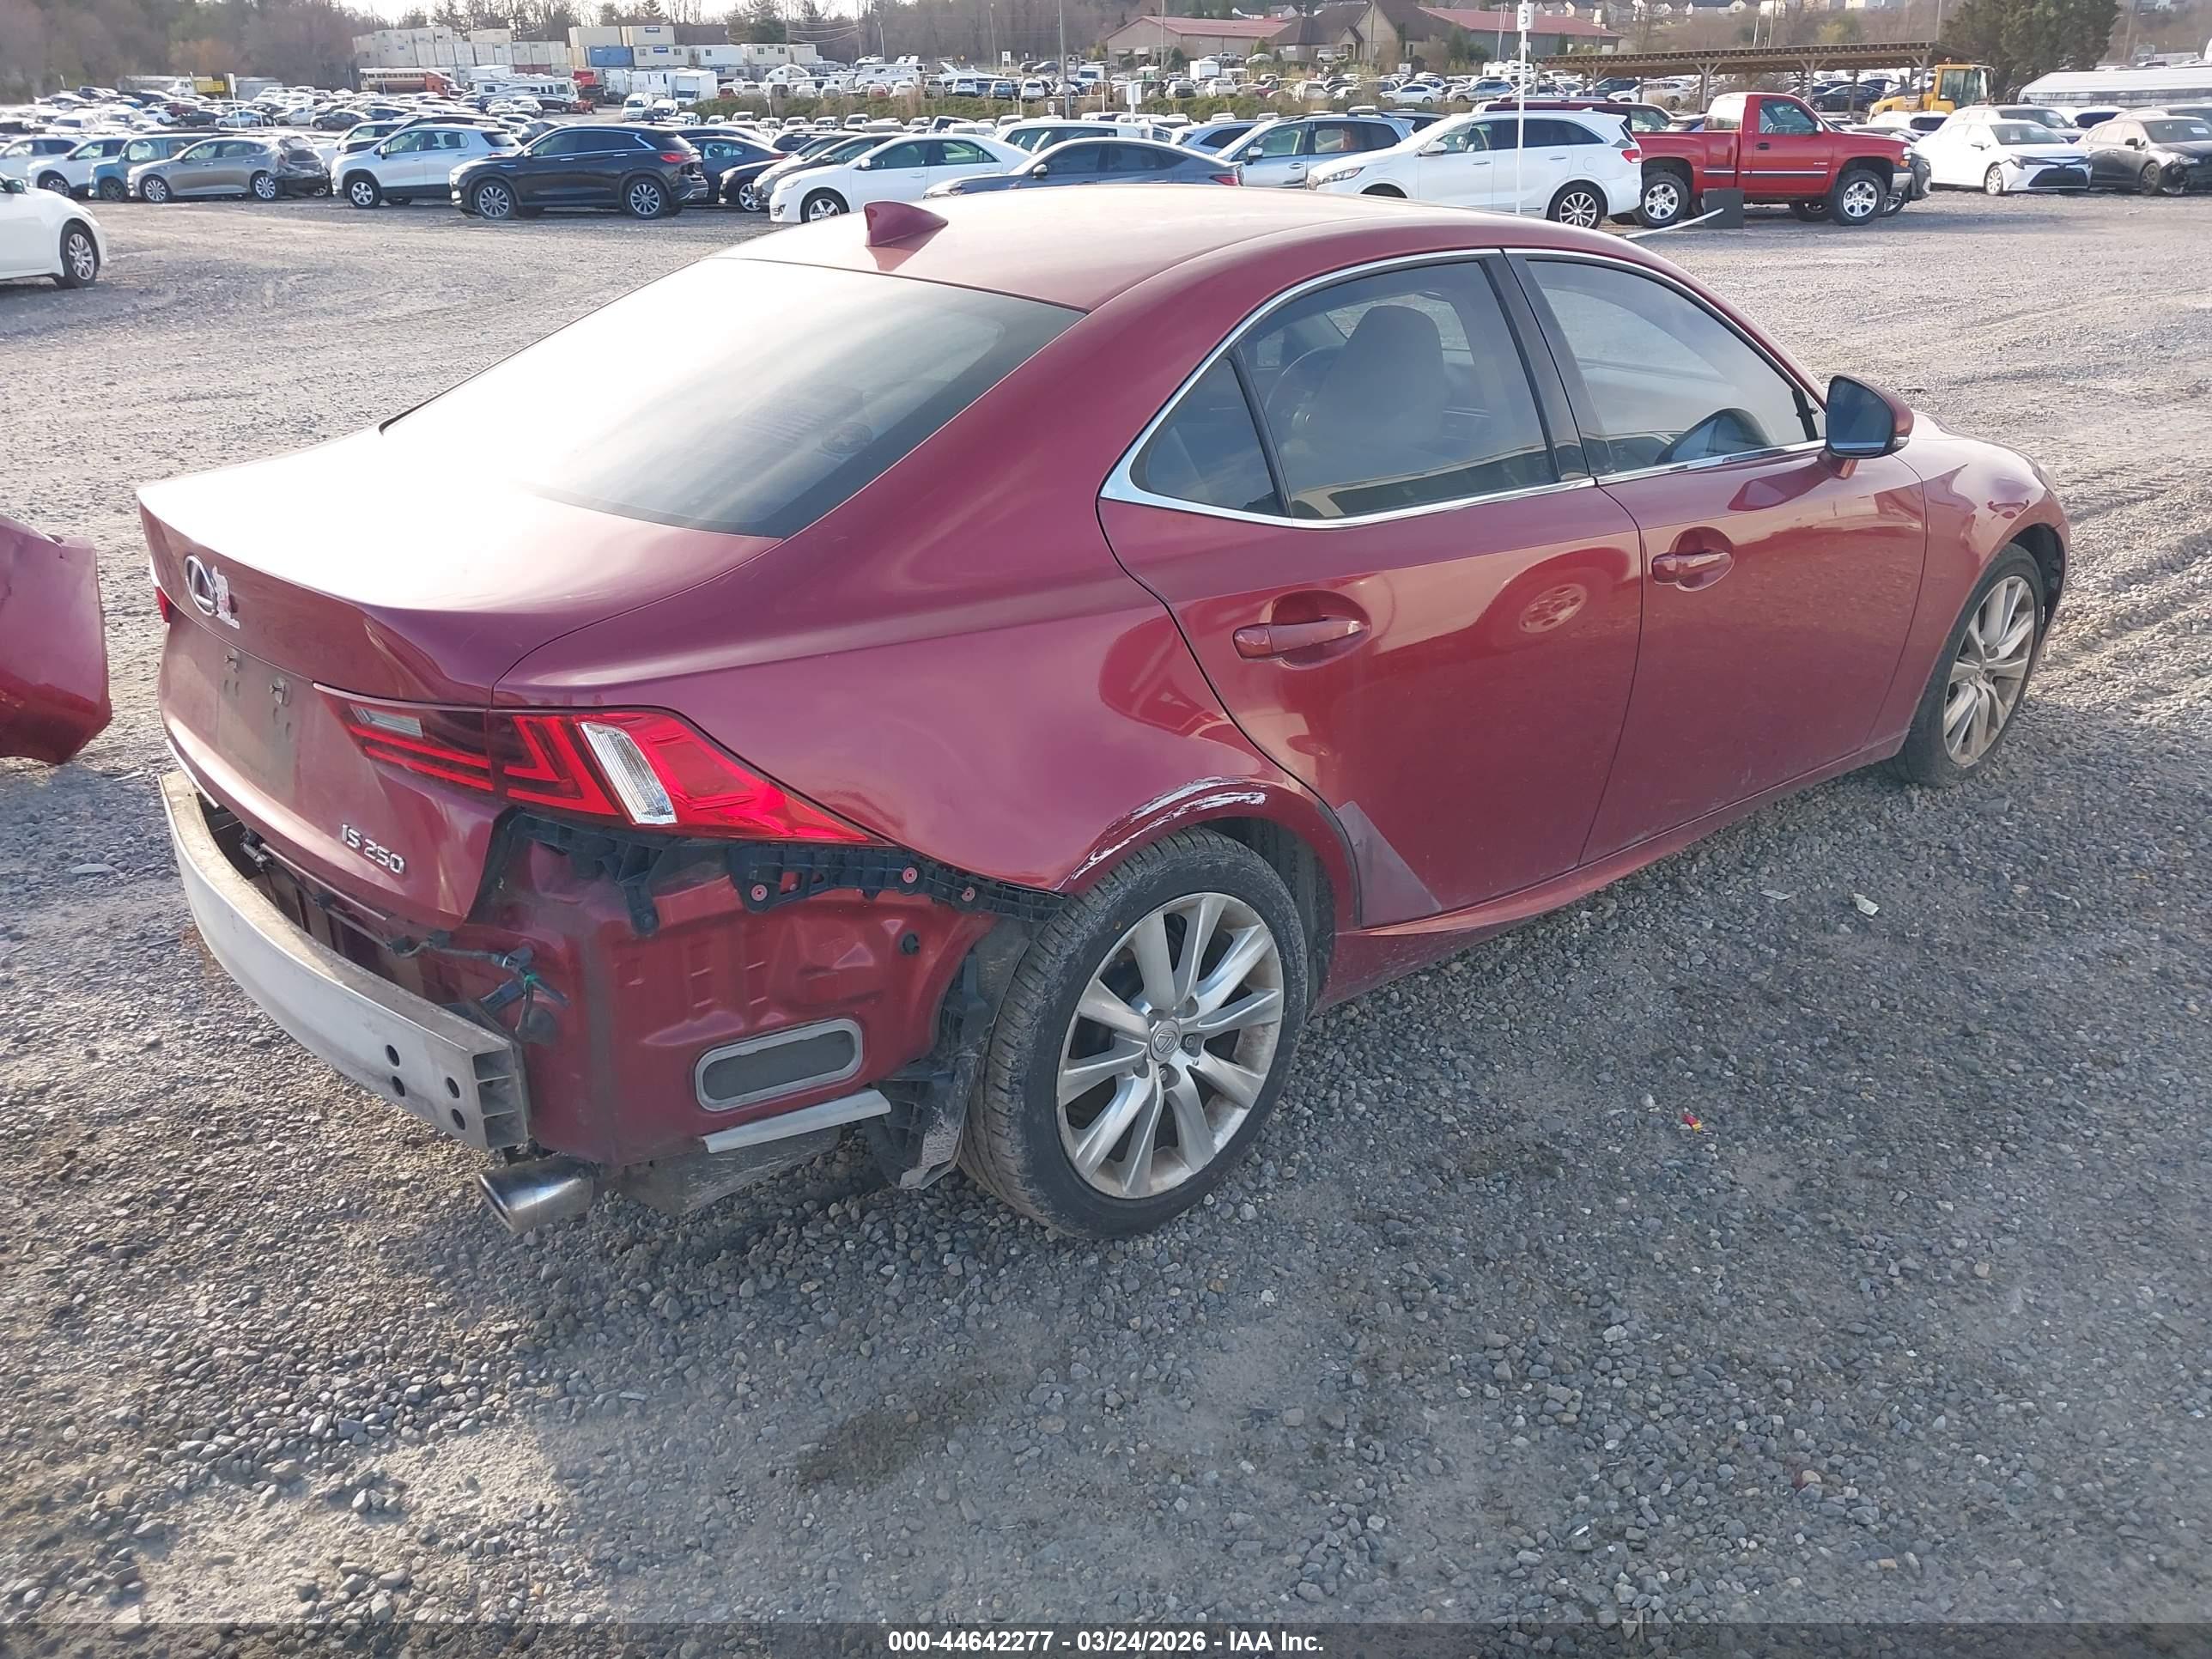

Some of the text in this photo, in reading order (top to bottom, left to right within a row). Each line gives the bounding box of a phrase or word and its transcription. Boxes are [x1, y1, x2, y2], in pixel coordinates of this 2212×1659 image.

[1520, 9, 1528, 25] G
[342, 823, 405, 874] IS 250
